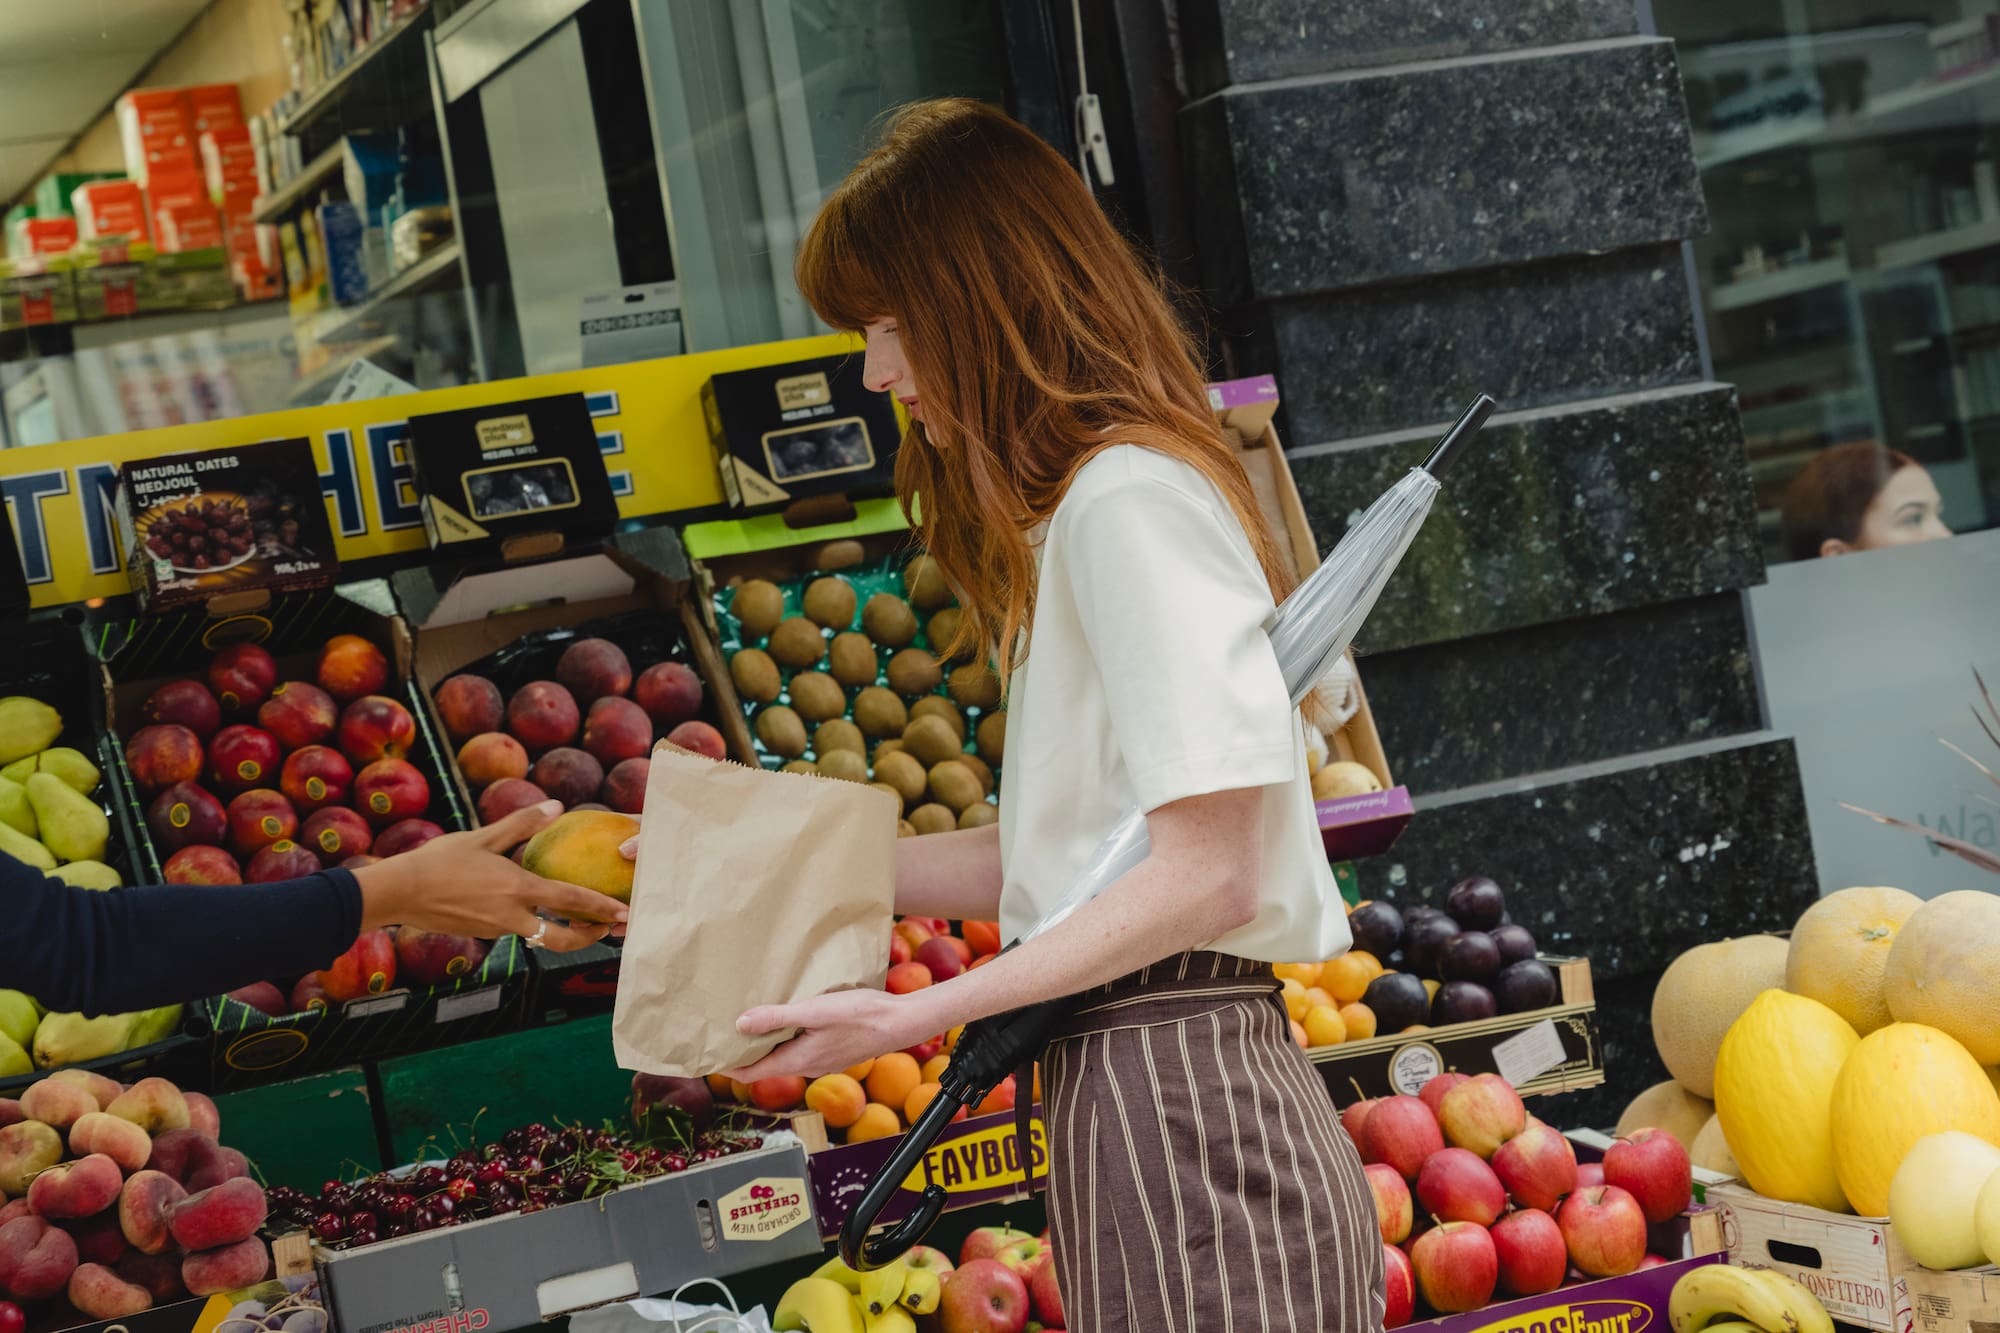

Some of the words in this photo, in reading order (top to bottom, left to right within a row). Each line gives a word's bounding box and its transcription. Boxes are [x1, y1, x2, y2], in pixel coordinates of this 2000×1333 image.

[131, 462, 194, 481] NATURAL
[195, 456, 240, 472] DATES
[134, 476, 199, 494] MEDJOUL
[730, 1193, 800, 1220] CHERRIES
[731, 1222, 756, 1234] VIEW
[757, 1208, 801, 1233] ORCHARD
[1798, 1272, 1885, 1310] CONFITERO
[395, 1316, 415, 1327] The
[417, 1309, 444, 1321] from
